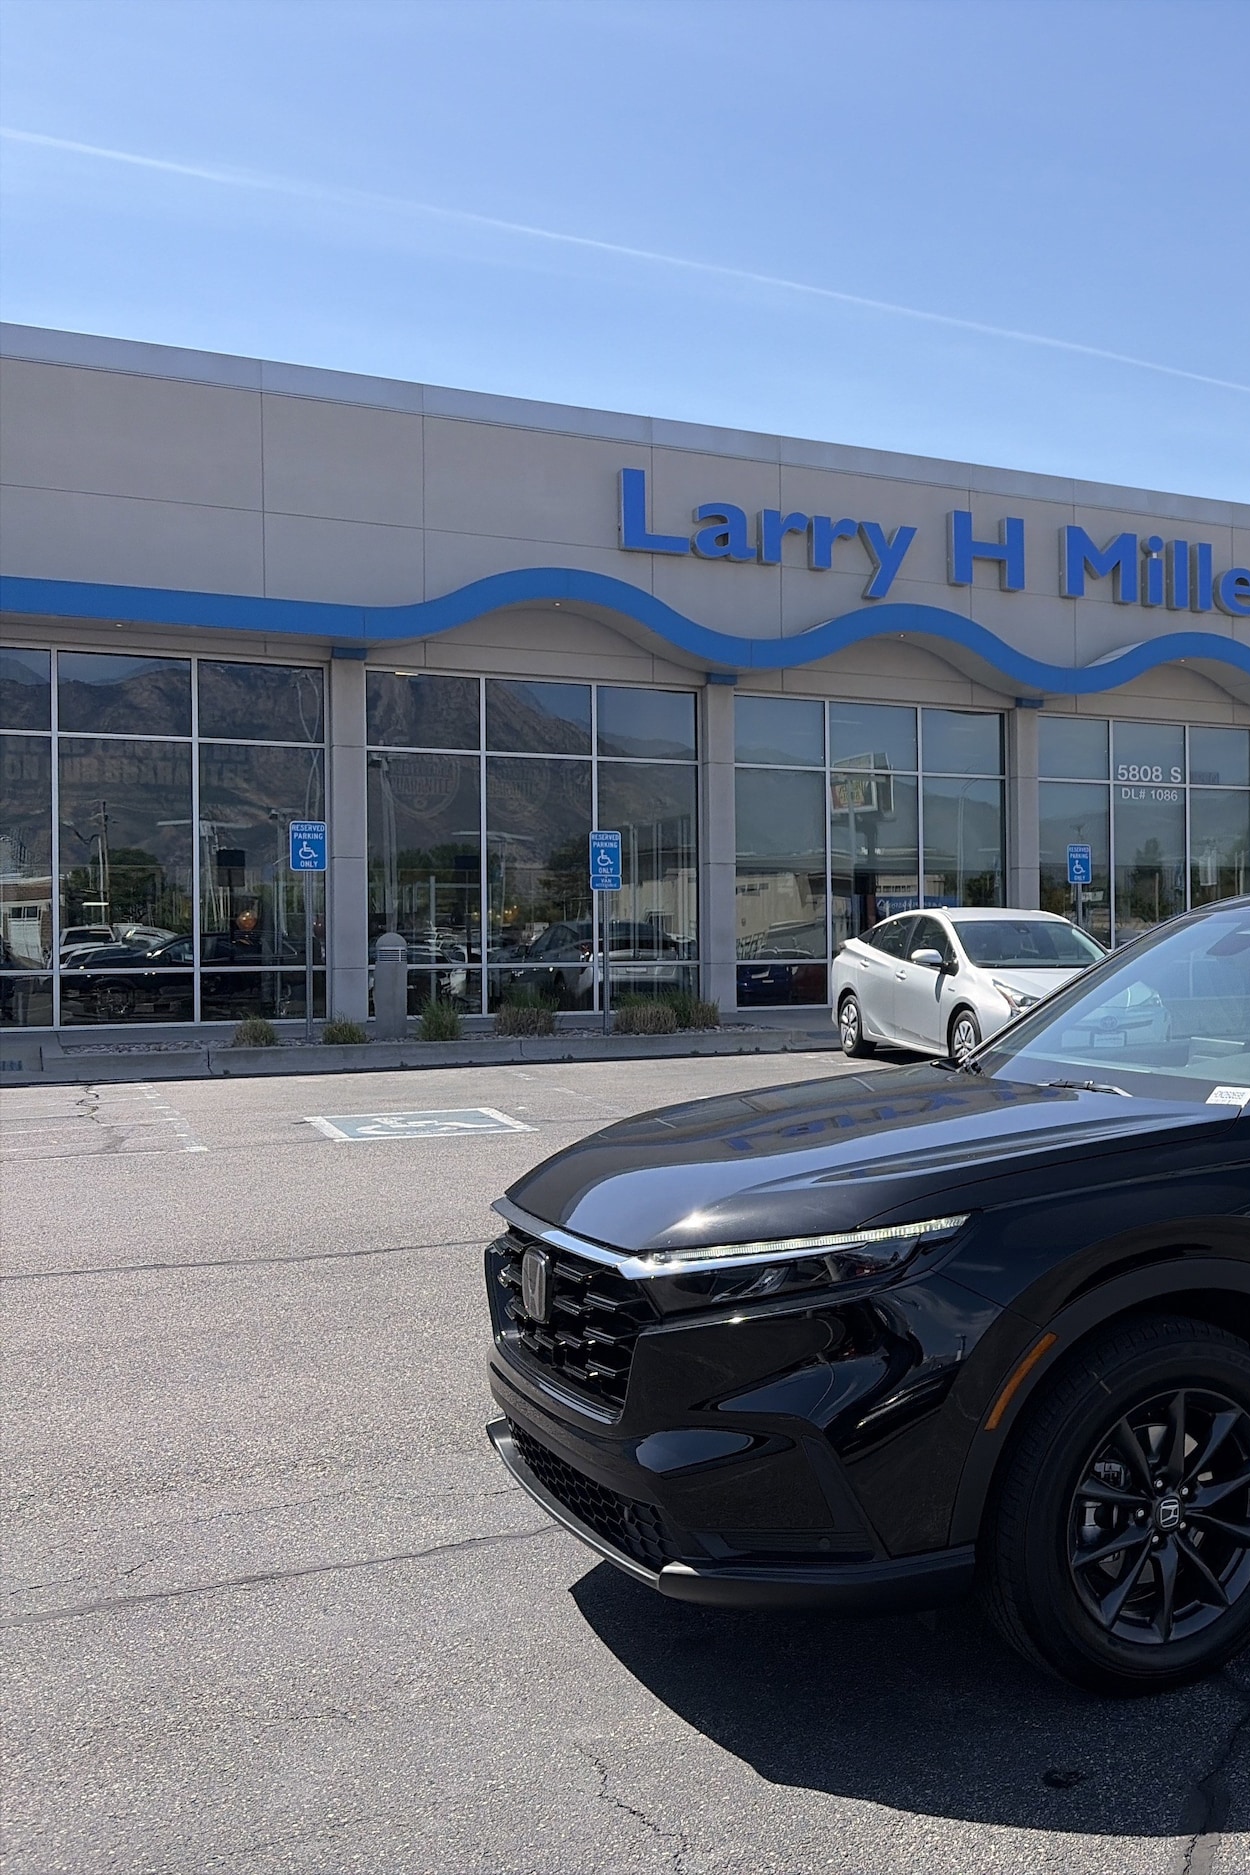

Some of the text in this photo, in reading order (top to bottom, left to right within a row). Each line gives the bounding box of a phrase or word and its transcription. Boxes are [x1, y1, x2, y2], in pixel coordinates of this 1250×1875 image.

[618, 468, 918, 600] Larry
[947, 510, 1025, 592] H
[1117, 764, 1182, 783] 5808 S
[1121, 787, 1178, 801] DL# 1086
[291, 824, 325, 832] RESERVED
[293, 832, 323, 840] PARKING
